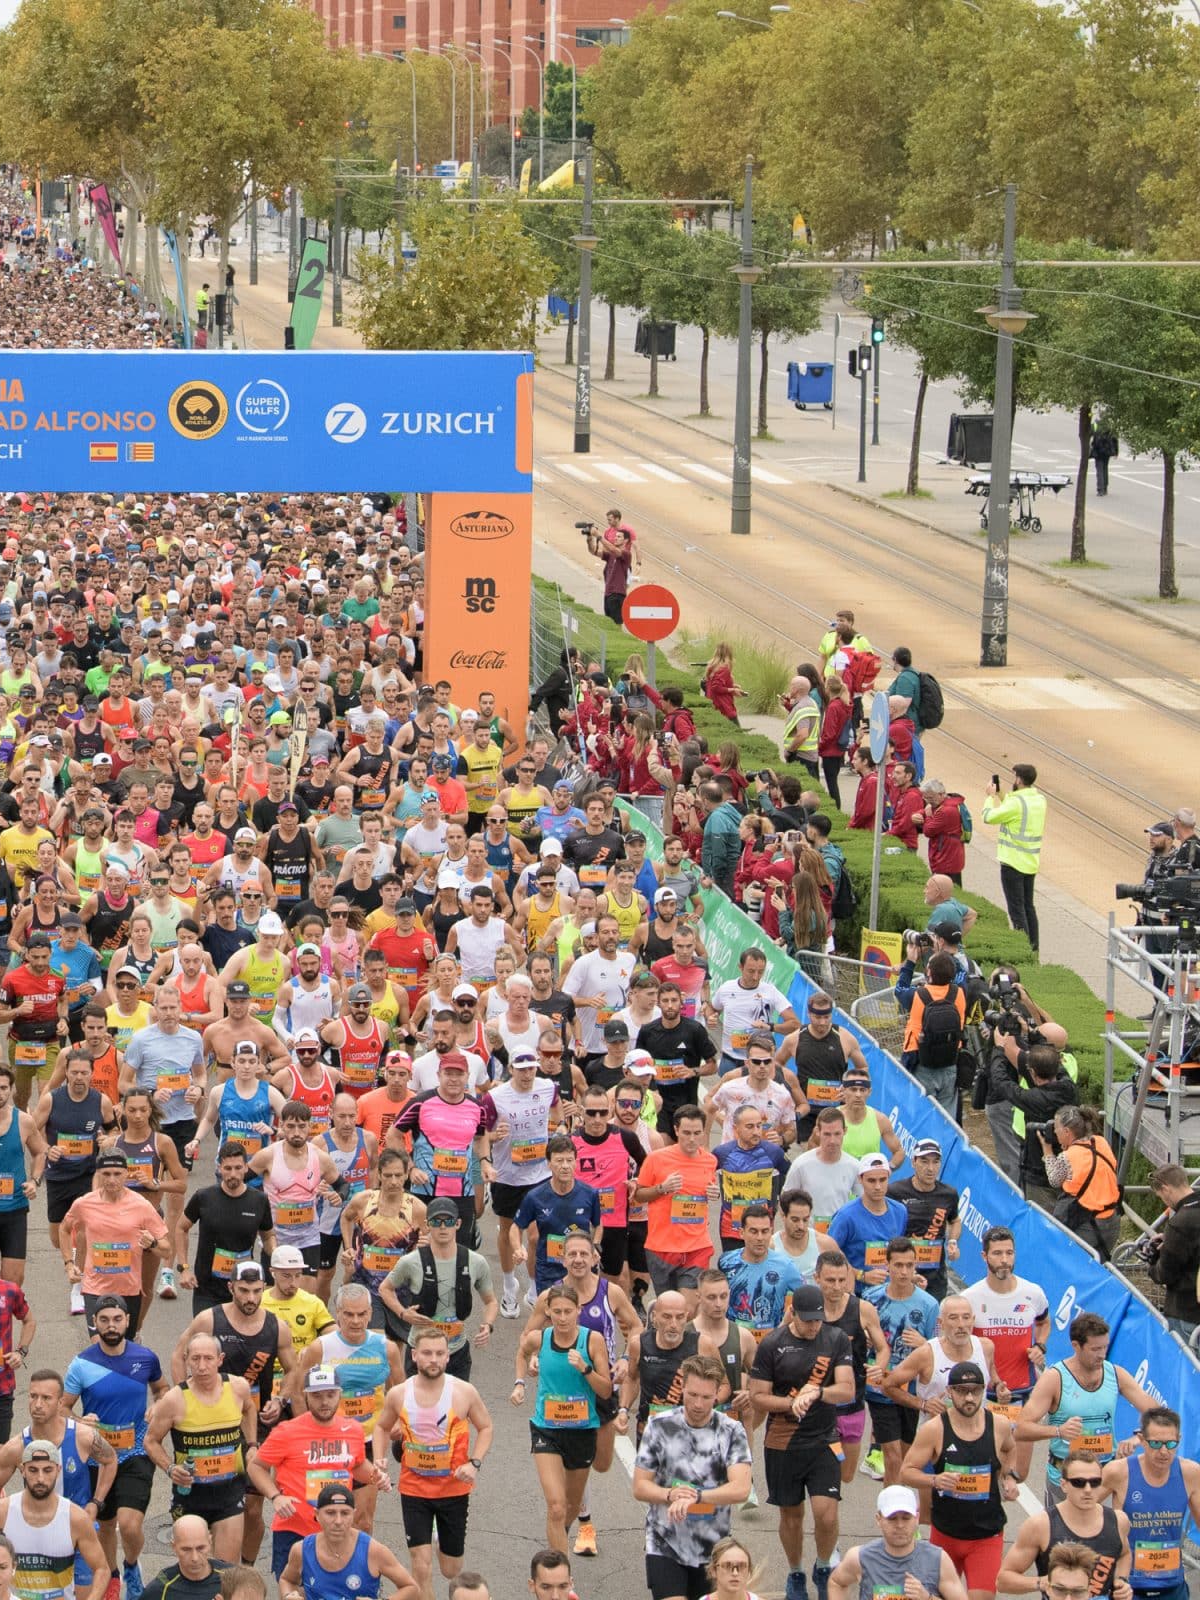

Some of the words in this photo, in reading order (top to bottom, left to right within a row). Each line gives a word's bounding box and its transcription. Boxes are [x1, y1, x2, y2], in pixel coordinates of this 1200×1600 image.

[297, 258, 325, 299] 2
[245, 397, 280, 406] SUPER
[245, 407, 280, 415] HALFS
[34, 411, 157, 432] ALFONSO
[381, 412, 495, 434] ZURICH
[456, 521, 509, 533] ASTURIANA
[450, 650, 505, 670] Coca-Cola
[273, 862, 307, 876] PRÁCTICO
[988, 1318, 1025, 1327] TRIATLO
[1130, 1519, 1183, 1529] ABERYSTWYT
[1149, 1527, 1167, 1536] A.C.
